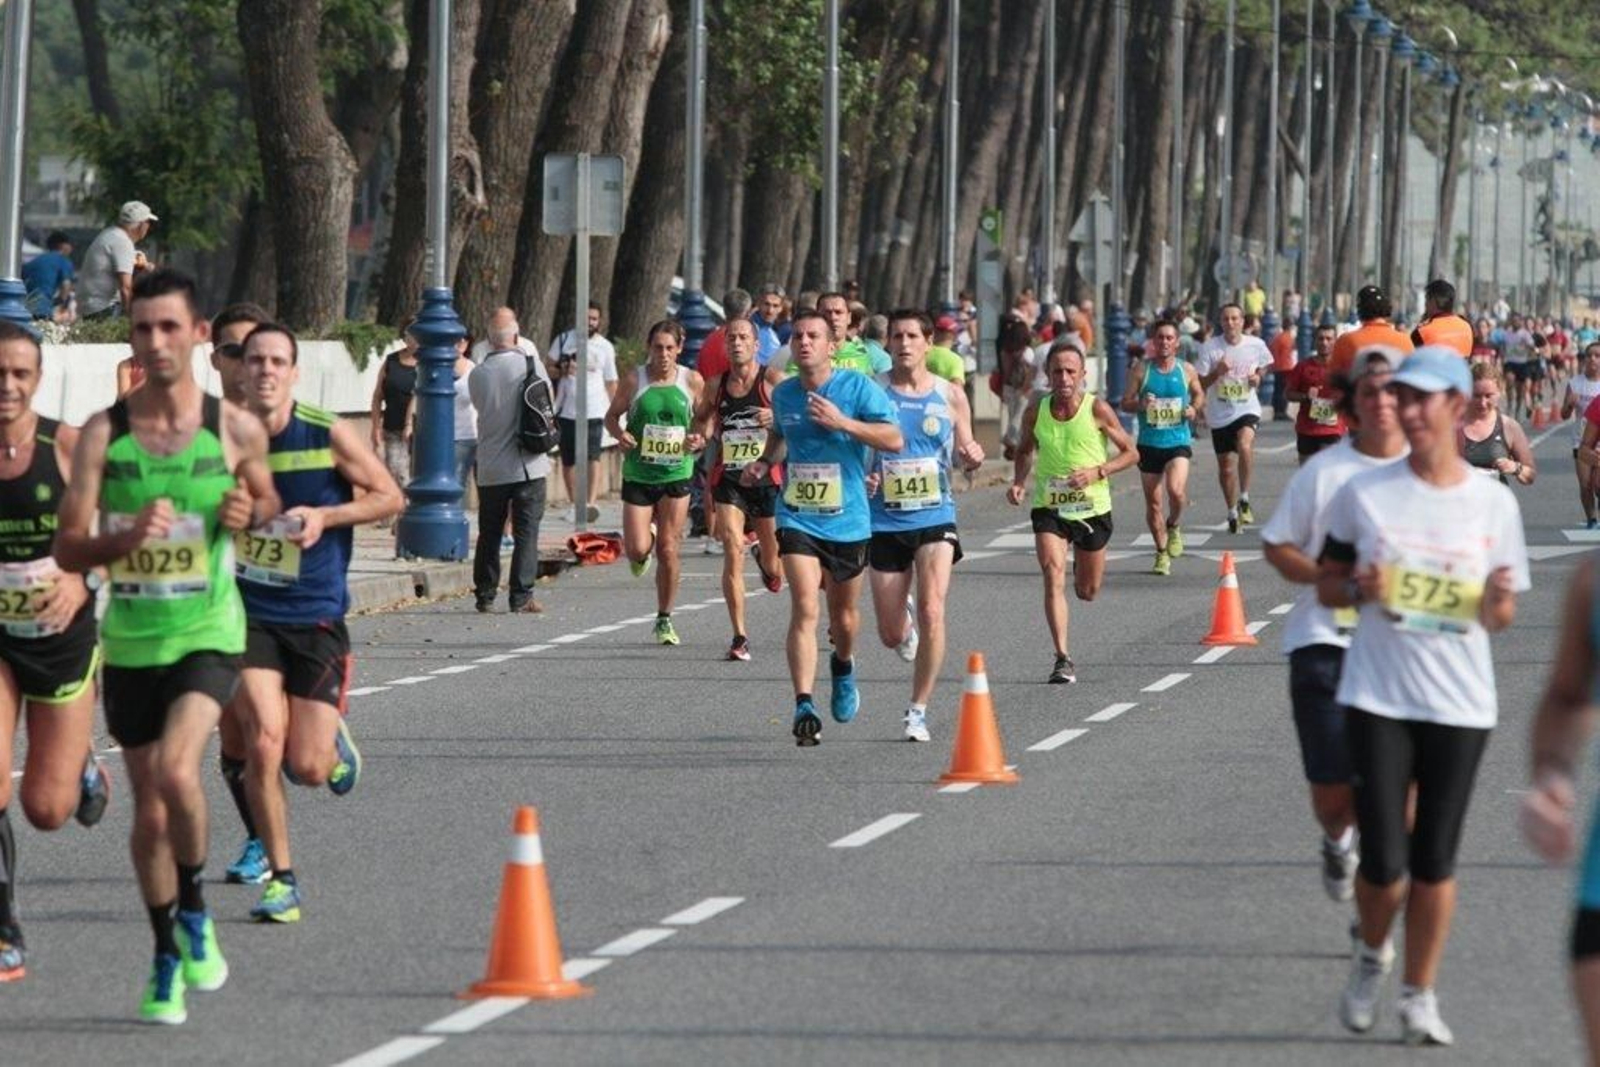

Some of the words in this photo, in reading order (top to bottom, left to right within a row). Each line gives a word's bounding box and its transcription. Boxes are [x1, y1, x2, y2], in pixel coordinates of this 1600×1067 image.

[647, 440, 681, 455] 1010
[730, 442, 760, 457] 776
[894, 476, 929, 495] 141
[1049, 491, 1087, 505] 1062
[124, 546, 194, 574] 1029
[1400, 571, 1462, 610] 575
